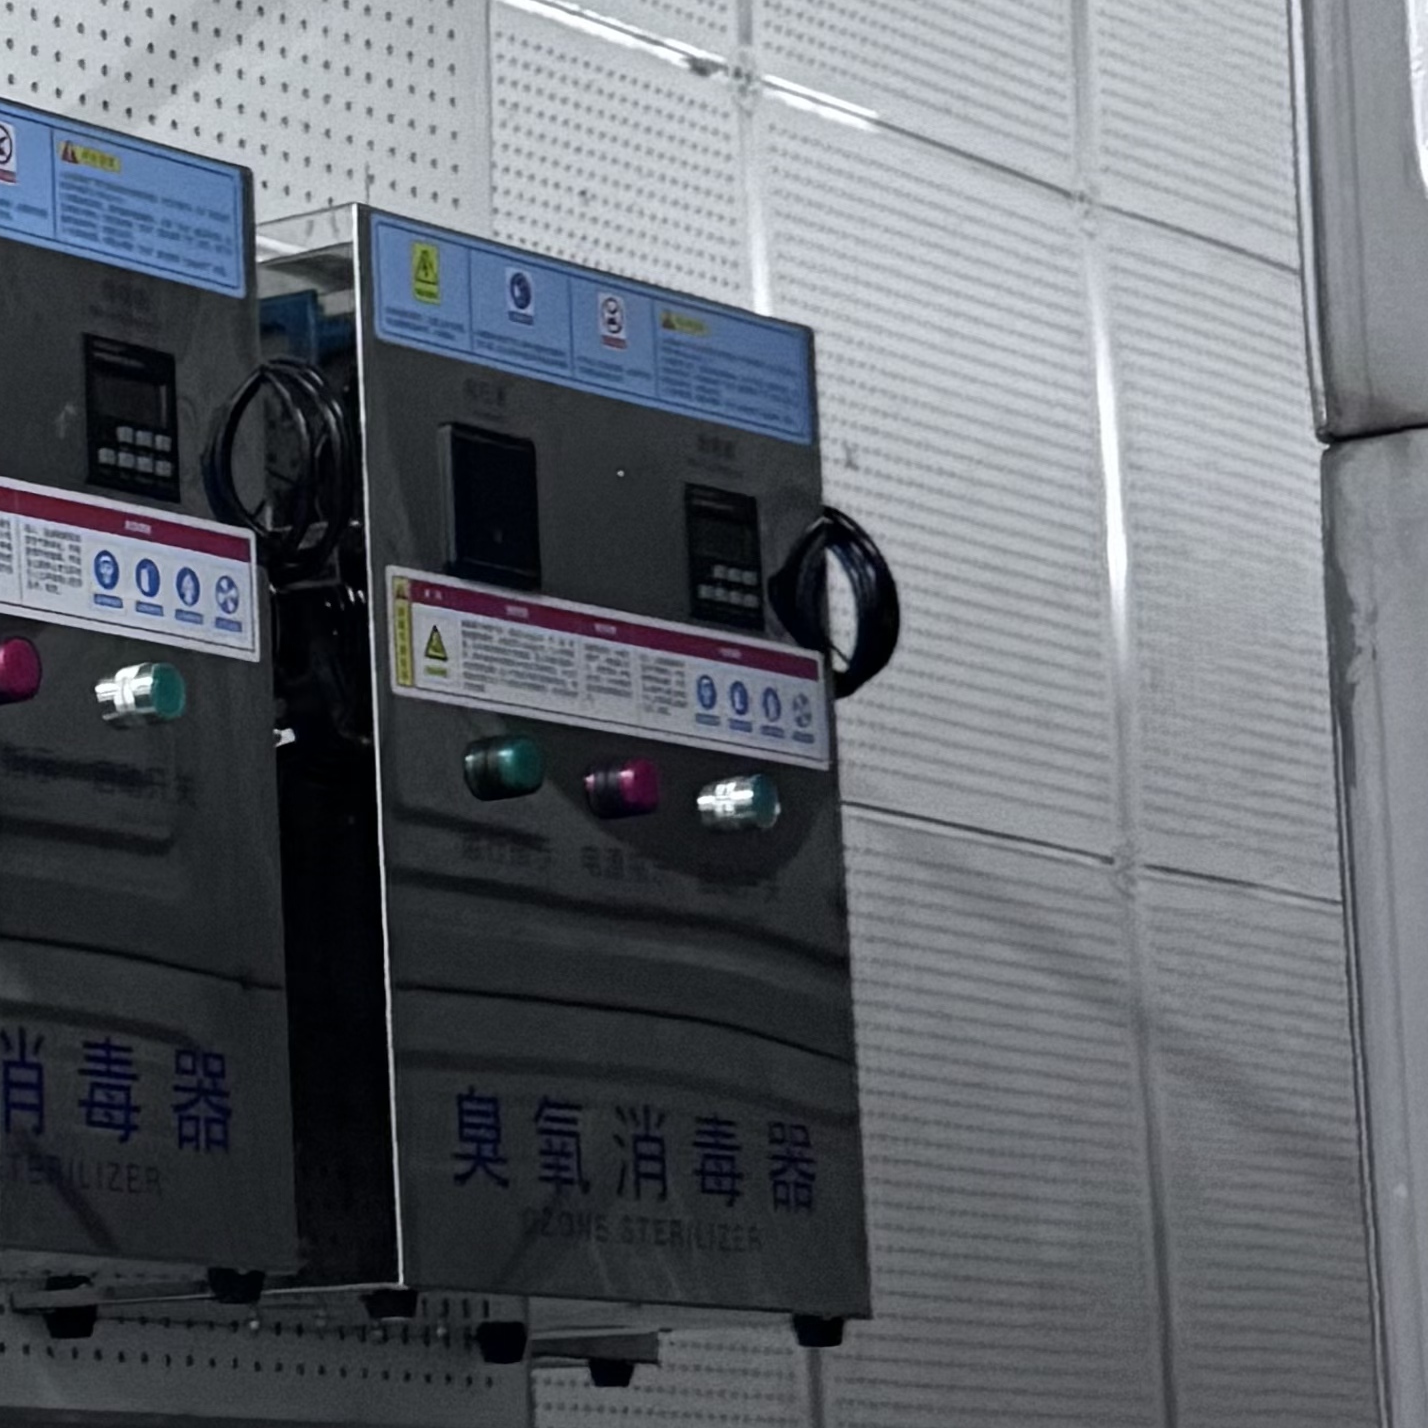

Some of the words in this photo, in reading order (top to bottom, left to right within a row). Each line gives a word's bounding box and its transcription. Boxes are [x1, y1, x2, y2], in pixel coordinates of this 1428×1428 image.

[452, 1086, 817, 1214] 臭氧消毒器
